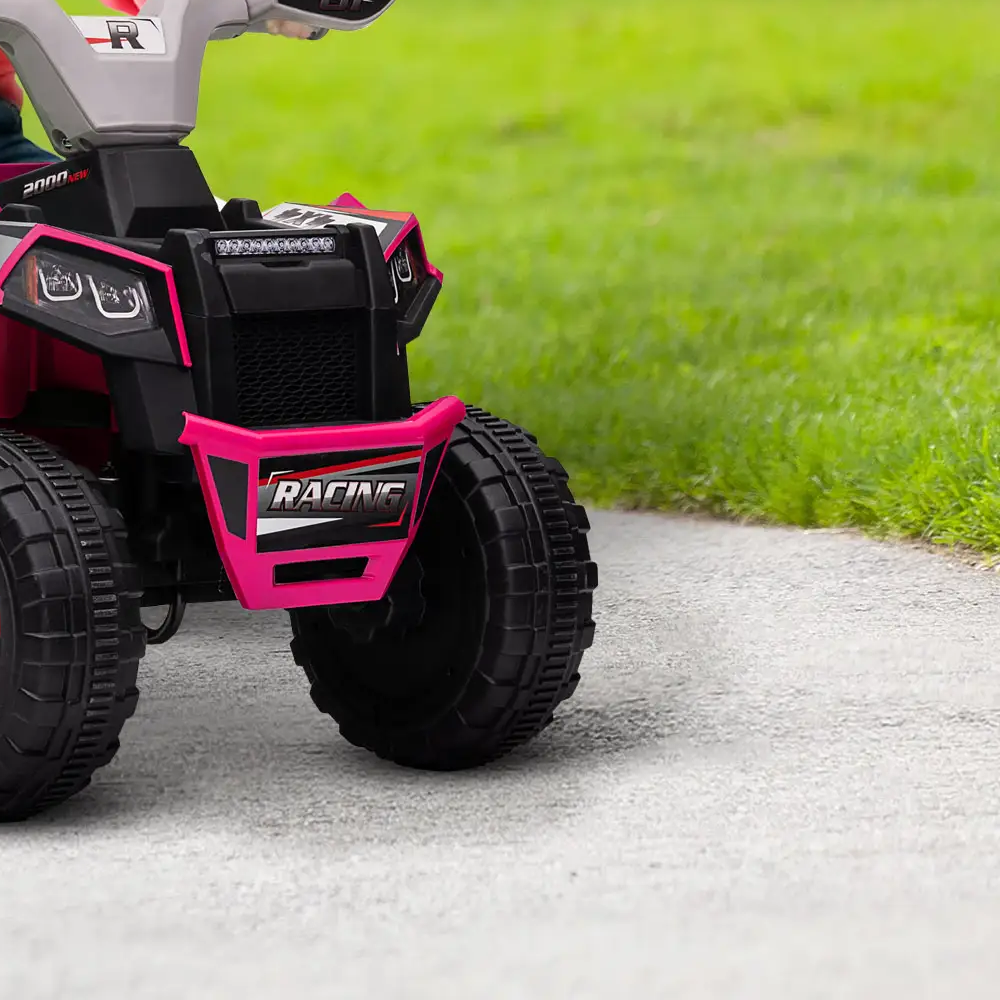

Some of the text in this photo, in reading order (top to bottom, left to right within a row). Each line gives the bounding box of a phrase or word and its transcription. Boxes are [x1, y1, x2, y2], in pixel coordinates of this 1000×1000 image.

[106, 20, 145, 49] R
[23, 168, 89, 199] 2000 NEW
[267, 479, 406, 513] RACING
